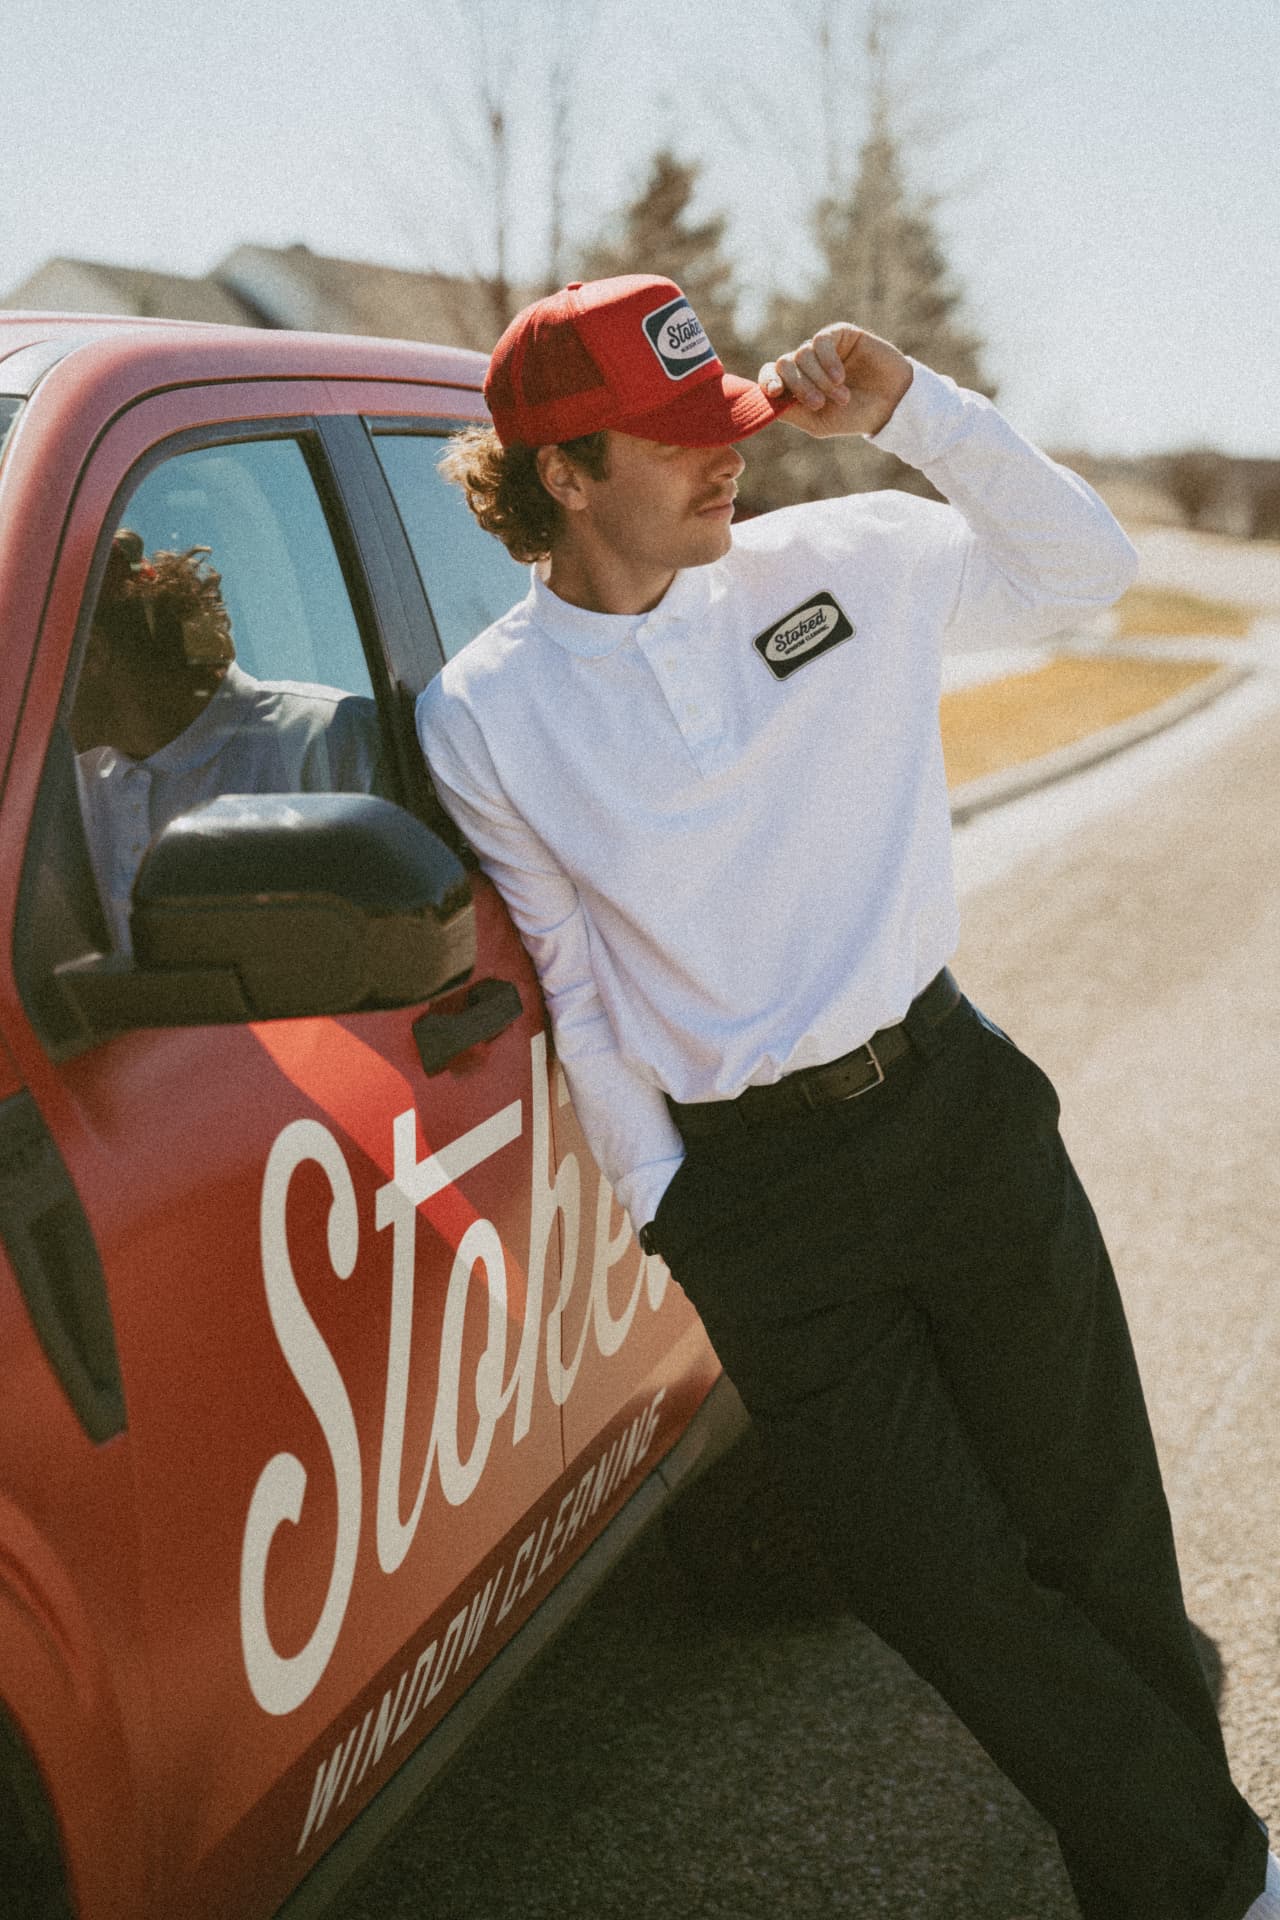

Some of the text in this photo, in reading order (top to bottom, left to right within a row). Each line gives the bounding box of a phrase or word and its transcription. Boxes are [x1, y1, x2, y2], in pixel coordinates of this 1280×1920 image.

[774, 607, 827, 652] Stoked
[240, 1030, 669, 1716] Stoke
[297, 1387, 667, 1854] WINDOW CLEANING
